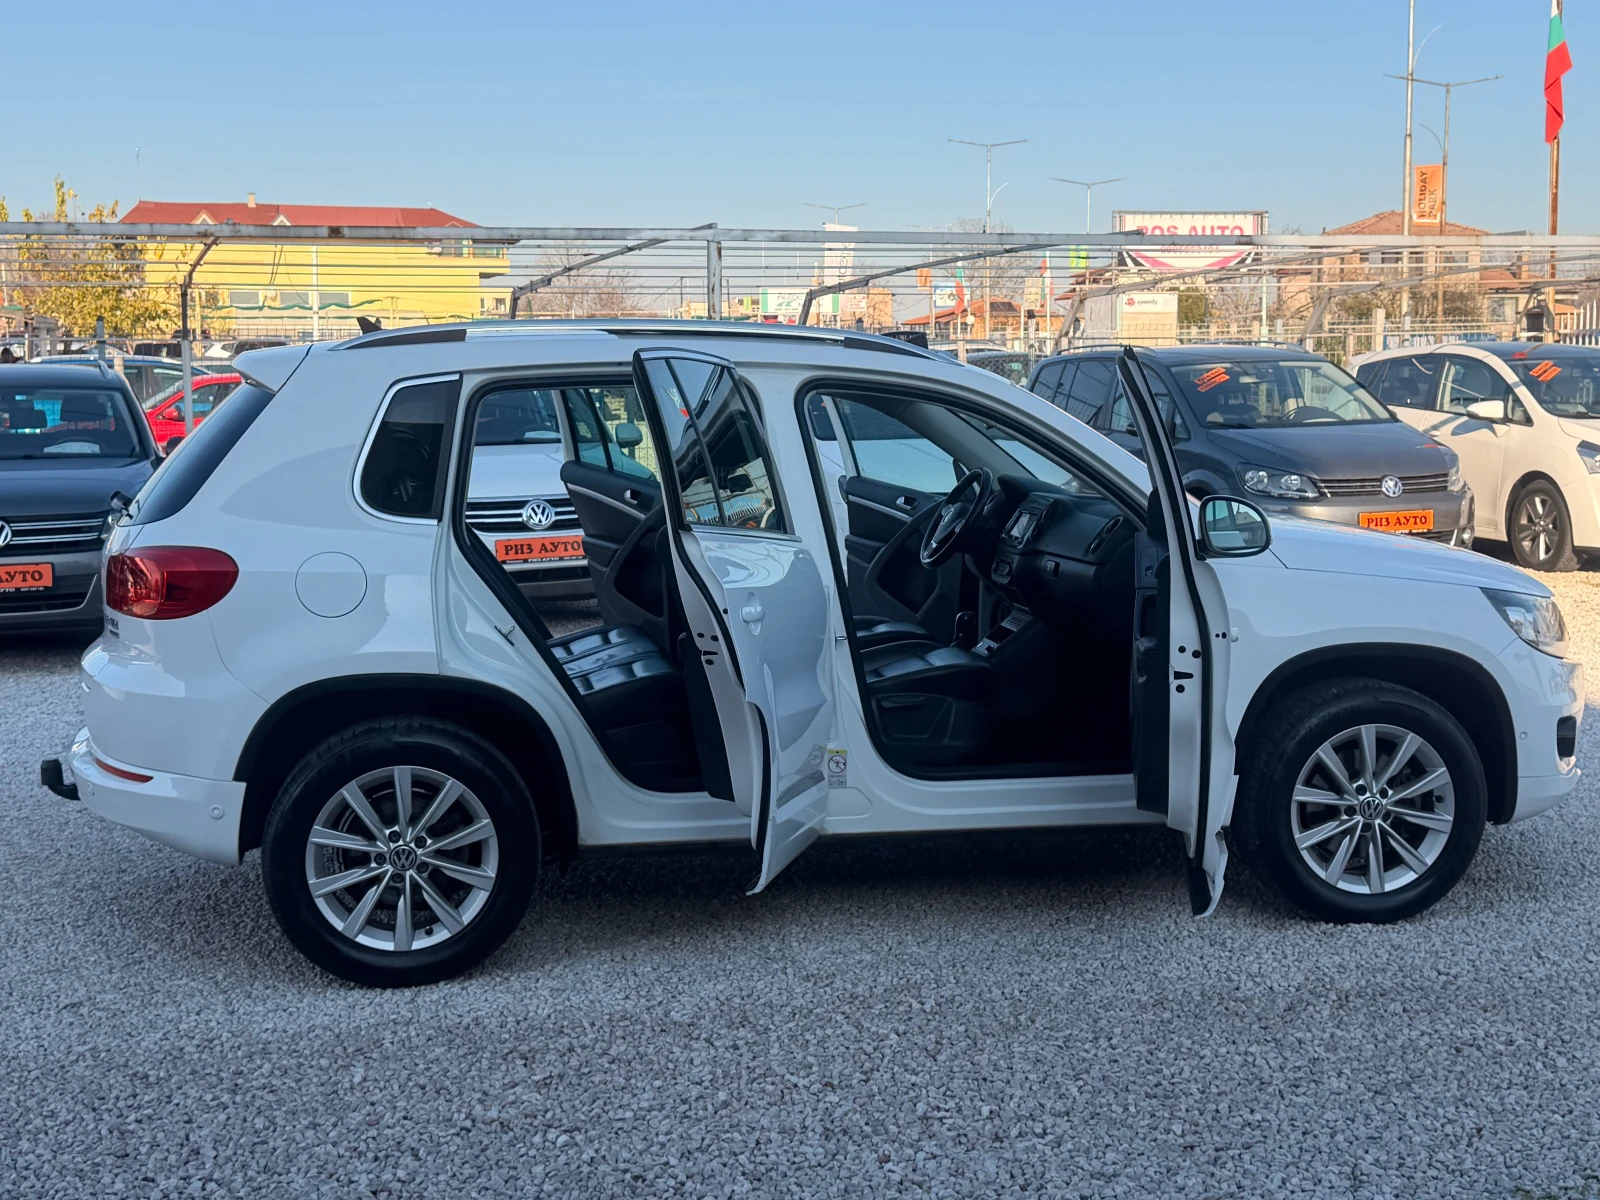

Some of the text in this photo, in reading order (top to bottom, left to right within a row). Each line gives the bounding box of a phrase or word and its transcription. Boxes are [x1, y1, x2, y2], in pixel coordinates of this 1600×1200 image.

[1418, 170, 1428, 218] HOLIDAY
[1428, 188, 1437, 217] PARK
[1367, 515, 1427, 528] РИЗ АУТО
[504, 540, 581, 556] РИЗ АУТО
